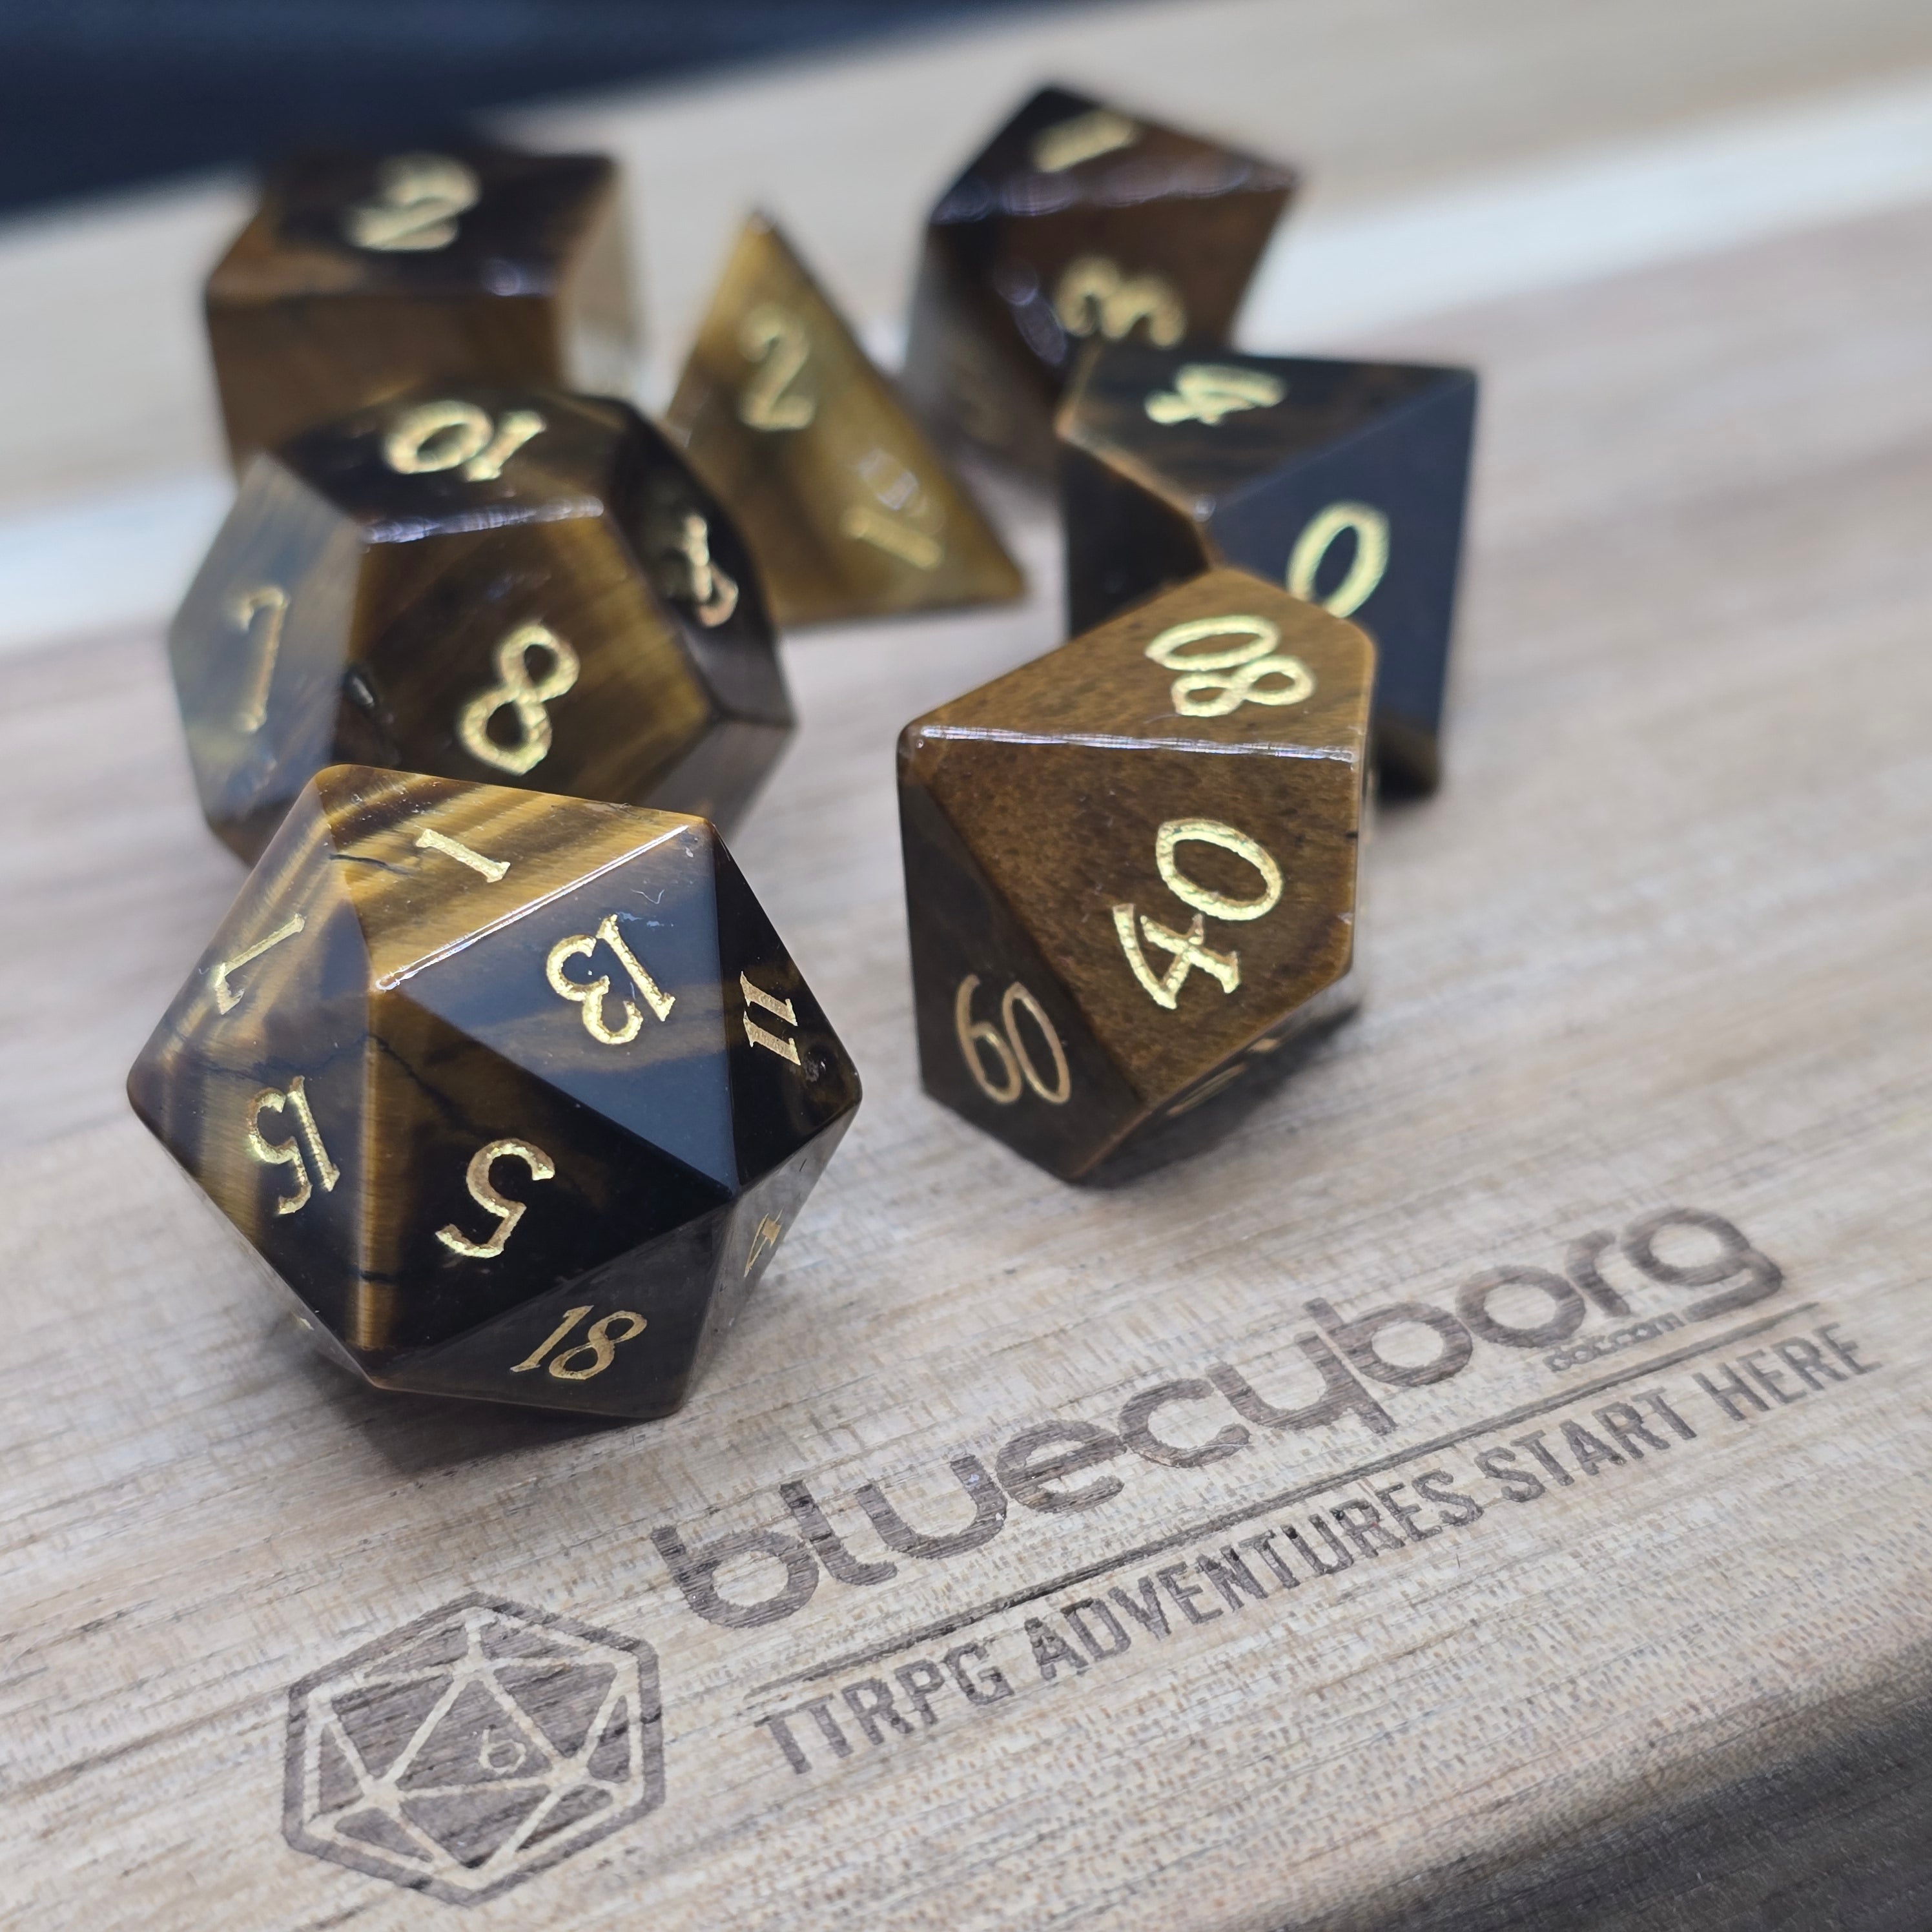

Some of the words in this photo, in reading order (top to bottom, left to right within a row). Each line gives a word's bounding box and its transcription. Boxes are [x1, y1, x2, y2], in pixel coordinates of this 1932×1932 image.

[349, 150, 482, 252] 2
[1054, 257, 1187, 349] 3
[736, 303, 816, 431] 2
[385, 398, 548, 482] 10
[1286, 500, 1391, 619] 0
[458, 621, 581, 775] 8
[1144, 613, 1317, 718] 80
[414, 828, 512, 883] 1
[1112, 816, 1285, 1010] 40
[546, 912, 676, 1045] 13
[739, 970, 801, 1066] 11
[956, 974, 1072, 1104] 60
[247, 1074, 340, 1215] 15
[435, 1137, 555, 1259] 5
[510, 1304, 648, 1381] 18
[649, 1206, 1786, 1630] bluecyborg
[753, 1641, 1016, 1775] TTRPG
[1023, 1467, 1485, 1680] ADVENTURES
[1473, 1387, 1698, 1504] START
[1690, 1323, 1882, 1423] HERE
